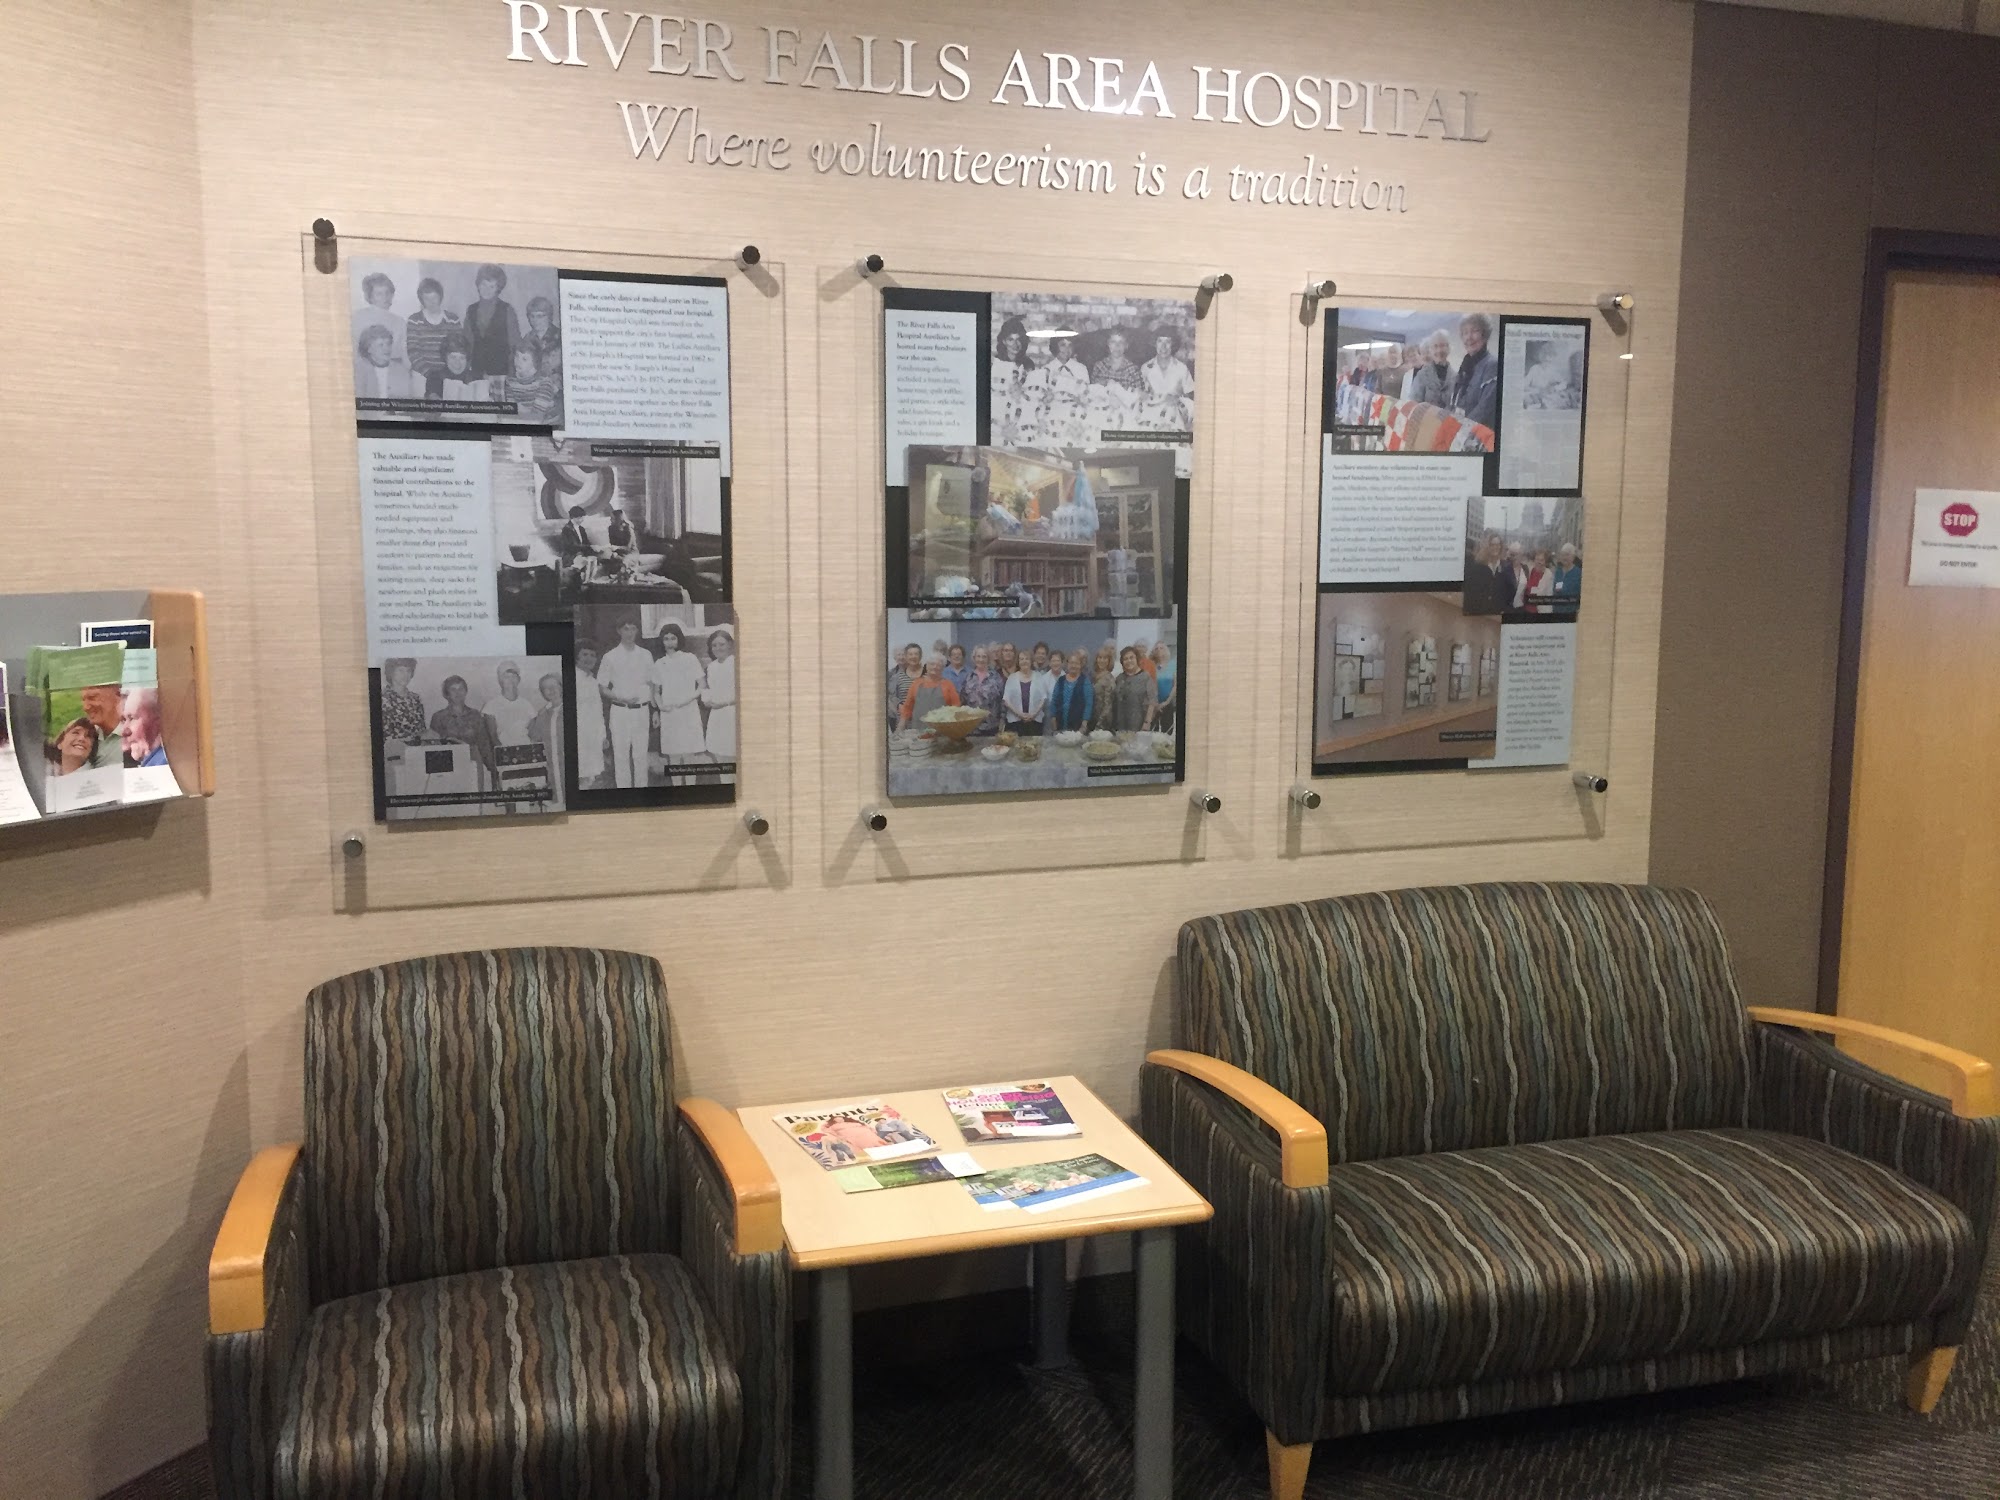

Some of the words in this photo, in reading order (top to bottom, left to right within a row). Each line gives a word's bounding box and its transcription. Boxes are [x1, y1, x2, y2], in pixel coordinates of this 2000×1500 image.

[506, 0, 744, 83] RIVER
[760, 24, 972, 103] FALLS
[991, 48, 1176, 119] AREA
[1191, 64, 1493, 143] HOSPITAL
[616, 100, 792, 170] Where
[811, 120, 1116, 195] volunteerism
[1133, 151, 1166, 197] is
[1182, 165, 1212, 200] a
[1227, 154, 1410, 214] tradition
[1943, 513, 1977, 527] STOP
[784, 1105, 880, 1124] Parents
